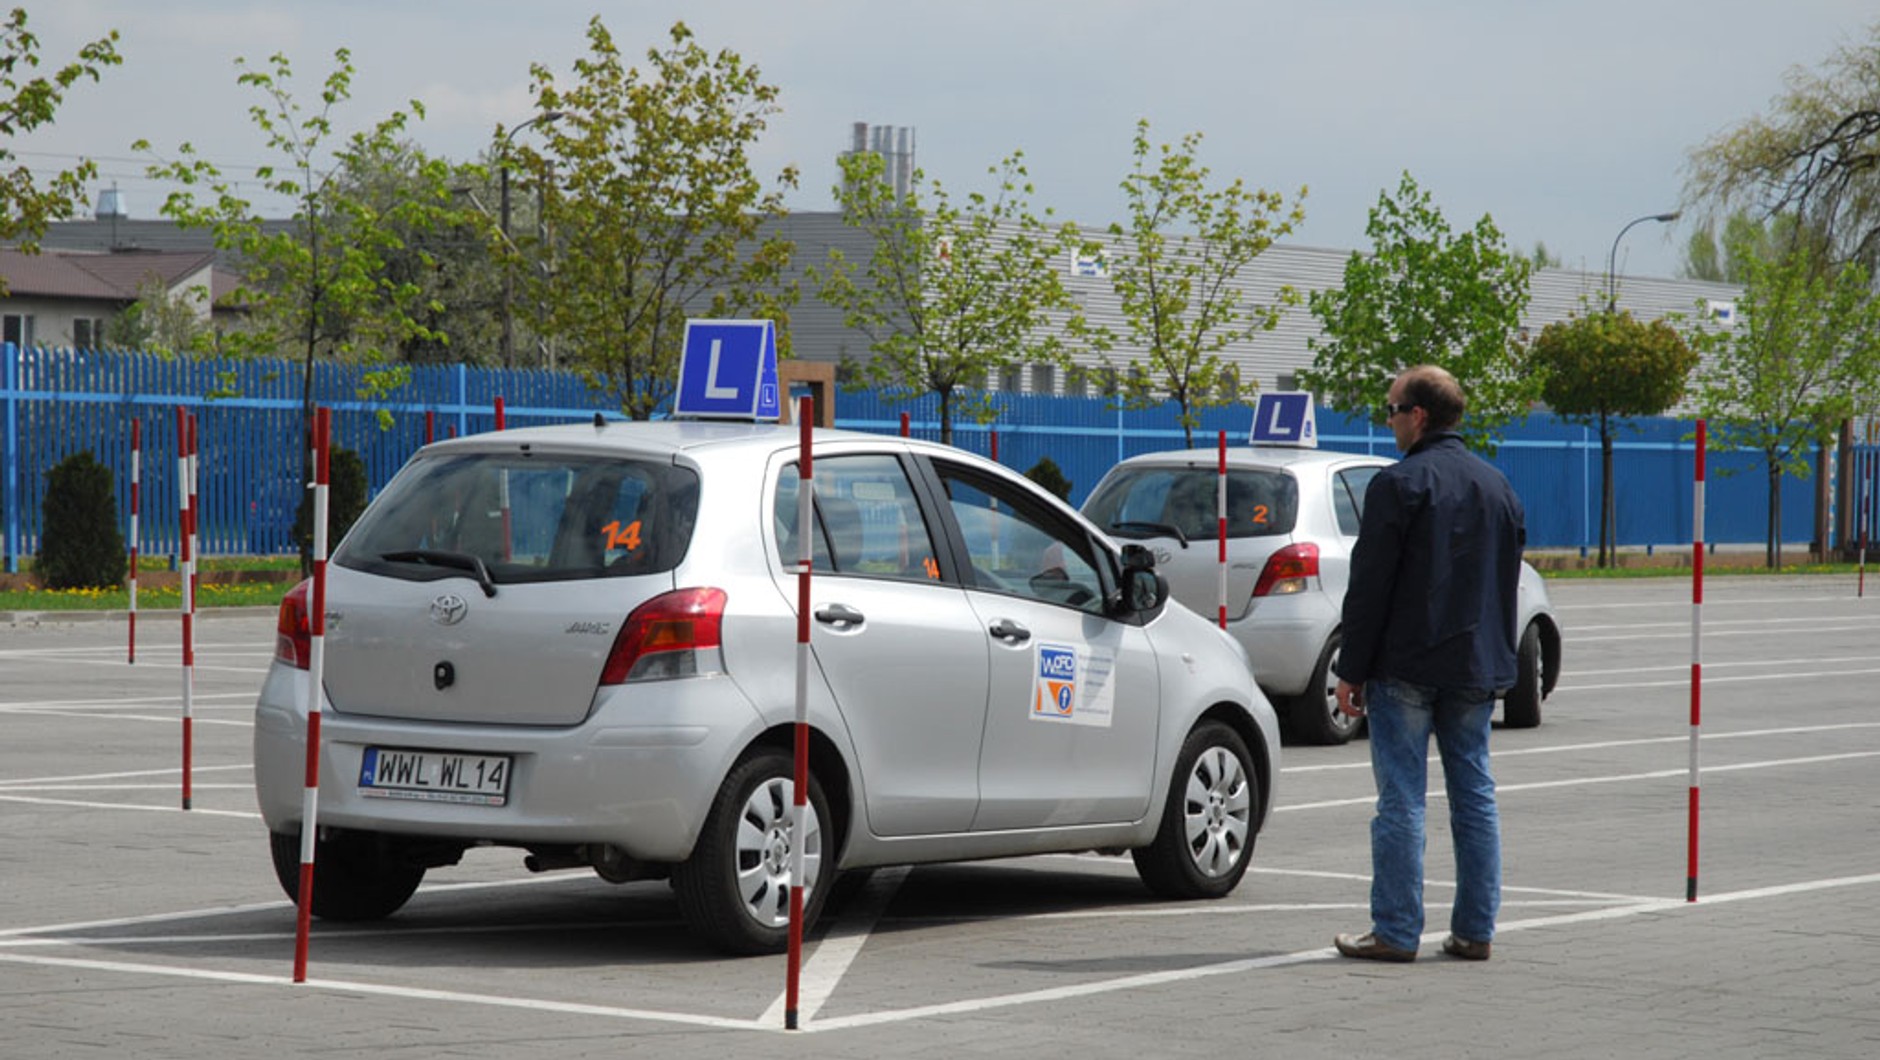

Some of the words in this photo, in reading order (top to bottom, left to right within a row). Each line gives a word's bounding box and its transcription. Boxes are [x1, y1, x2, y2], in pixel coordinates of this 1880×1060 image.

[705, 338, 739, 399] L
[765, 387, 773, 403] L
[1268, 401, 1291, 435] L
[1252, 505, 1268, 523] 2
[601, 520, 642, 550] 14
[378, 753, 429, 786] WWL
[440, 757, 505, 791] WL14
